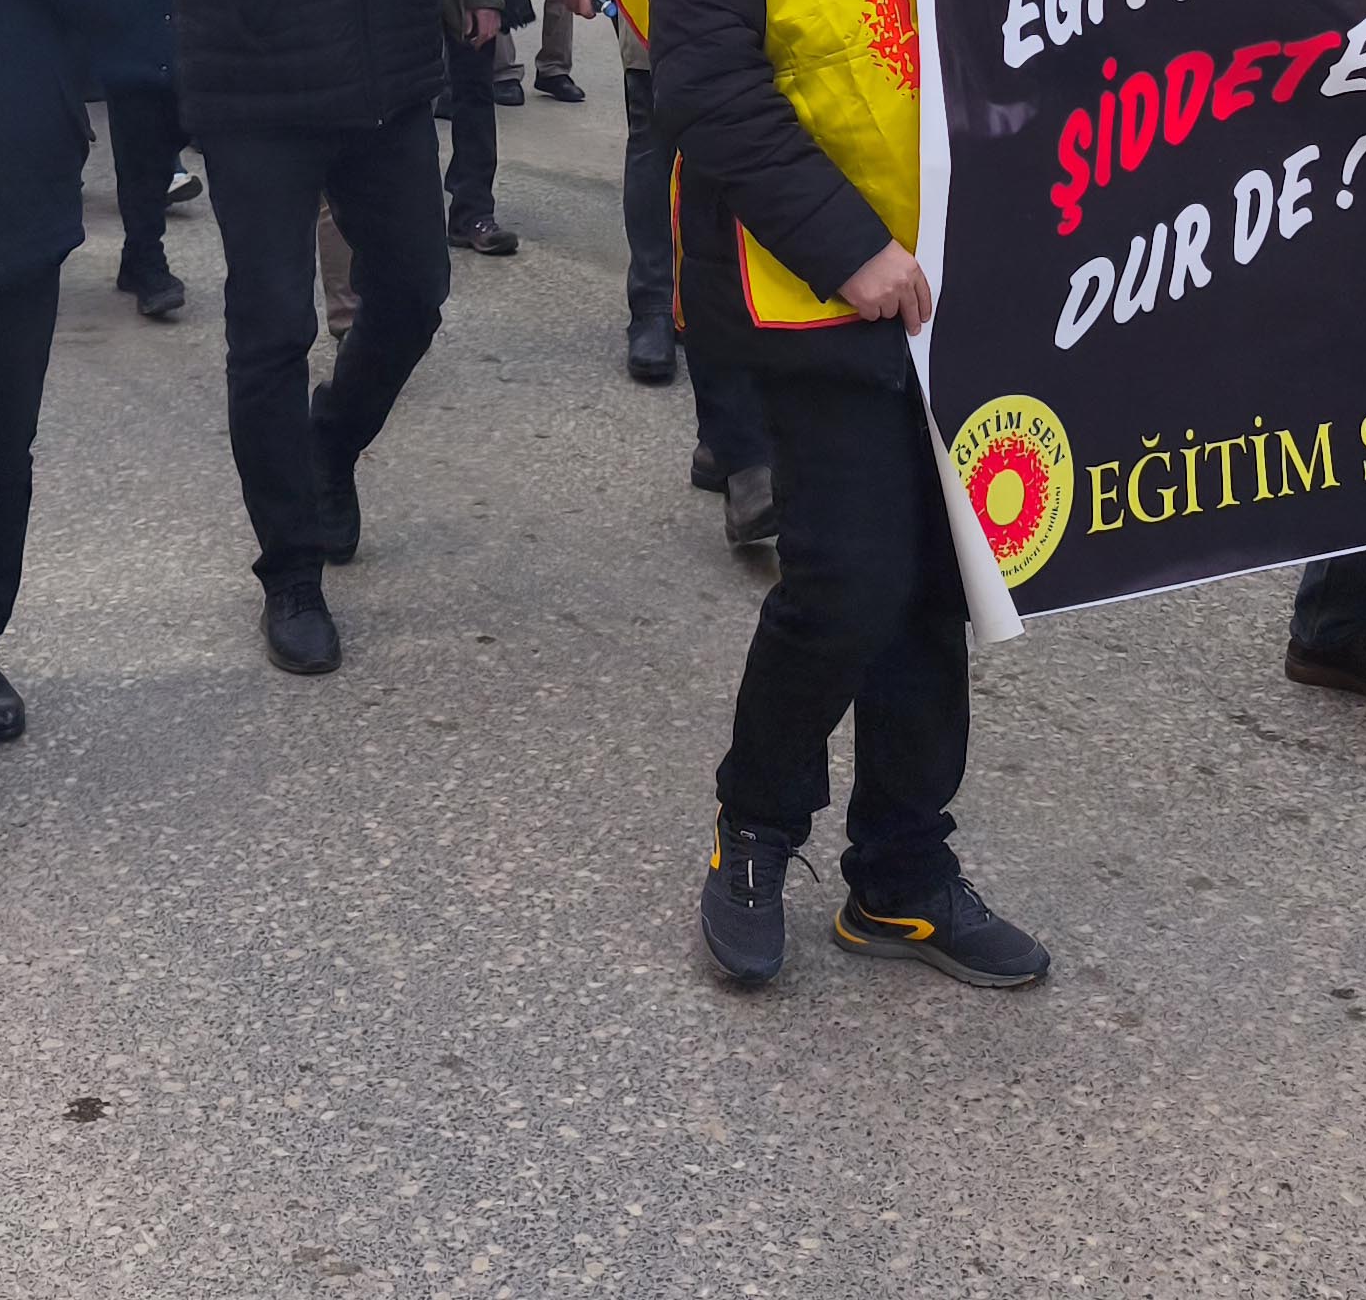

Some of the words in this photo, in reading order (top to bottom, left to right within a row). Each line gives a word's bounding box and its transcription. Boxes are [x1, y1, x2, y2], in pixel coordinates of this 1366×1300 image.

[1054, 203, 1212, 350] DUR
[955, 409, 1022, 470] ĞİTİM
[1028, 417, 1067, 467] SEN
[1086, 414, 1341, 535] EĞİTİM
